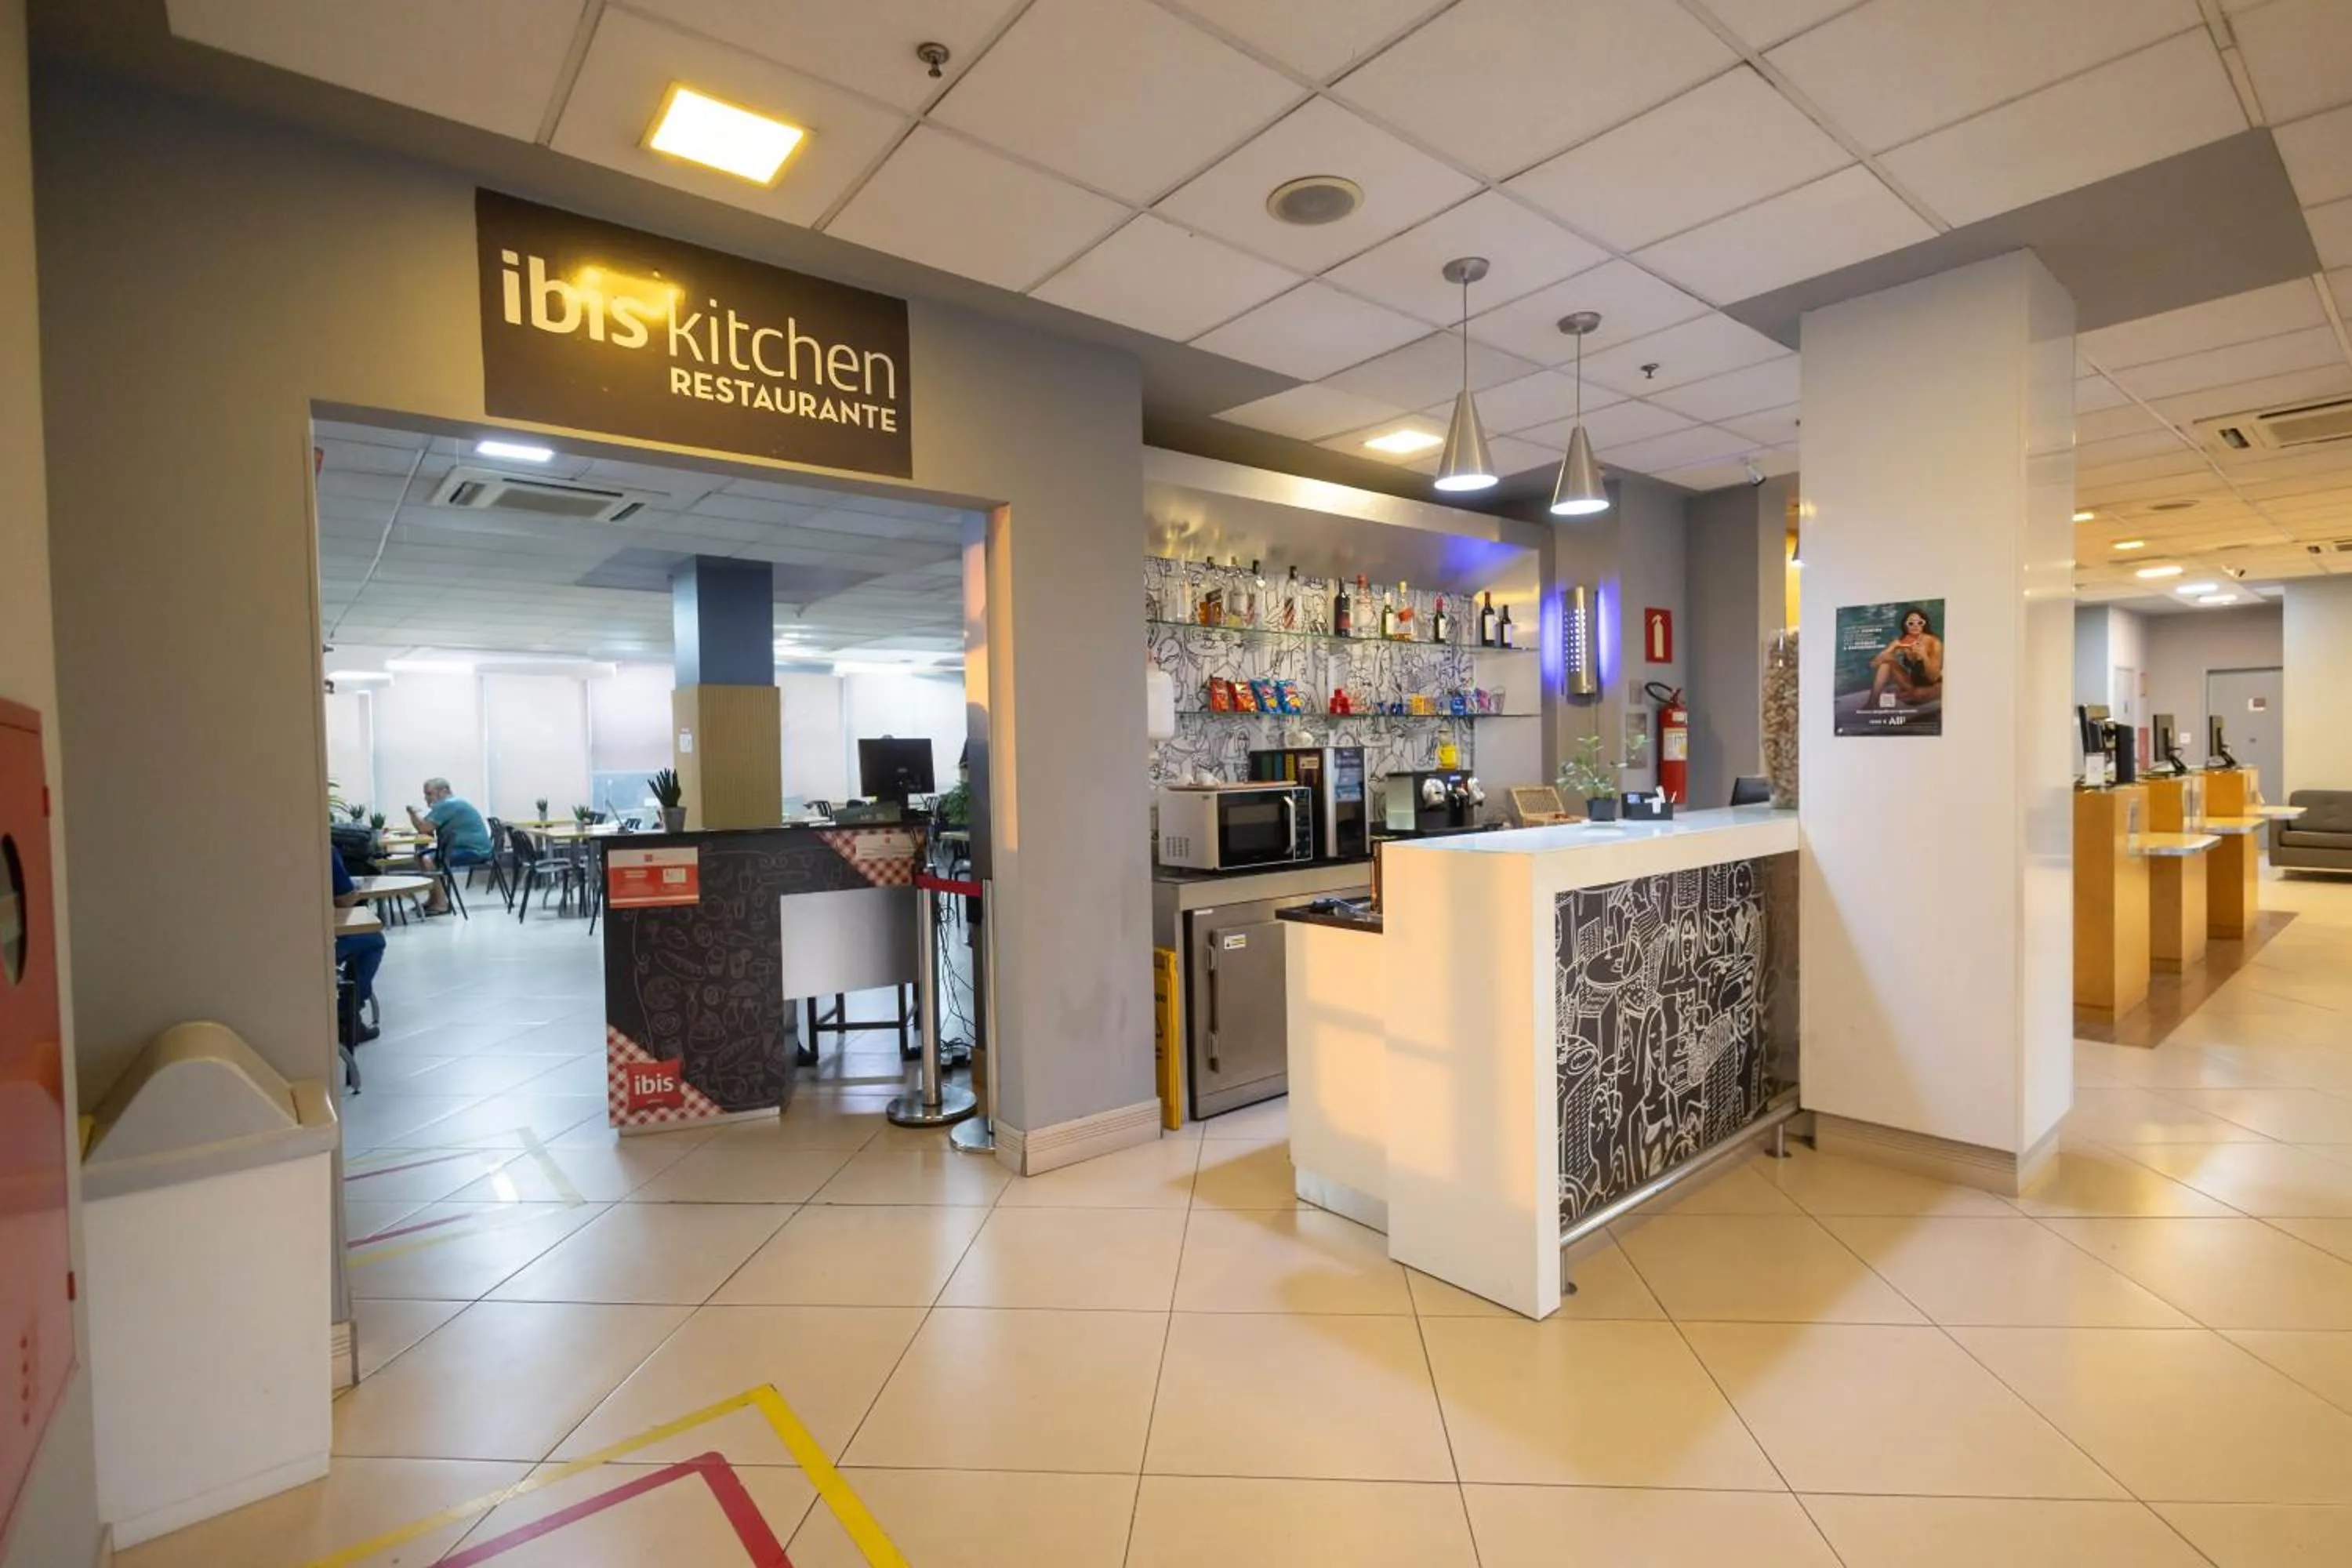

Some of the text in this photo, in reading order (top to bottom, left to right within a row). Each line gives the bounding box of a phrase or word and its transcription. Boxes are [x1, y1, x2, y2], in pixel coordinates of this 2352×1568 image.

[500, 249, 896, 400] ibis kitchen
[670, 367, 898, 433] RESTAURANTE
[634, 1073, 673, 1095] ibis
